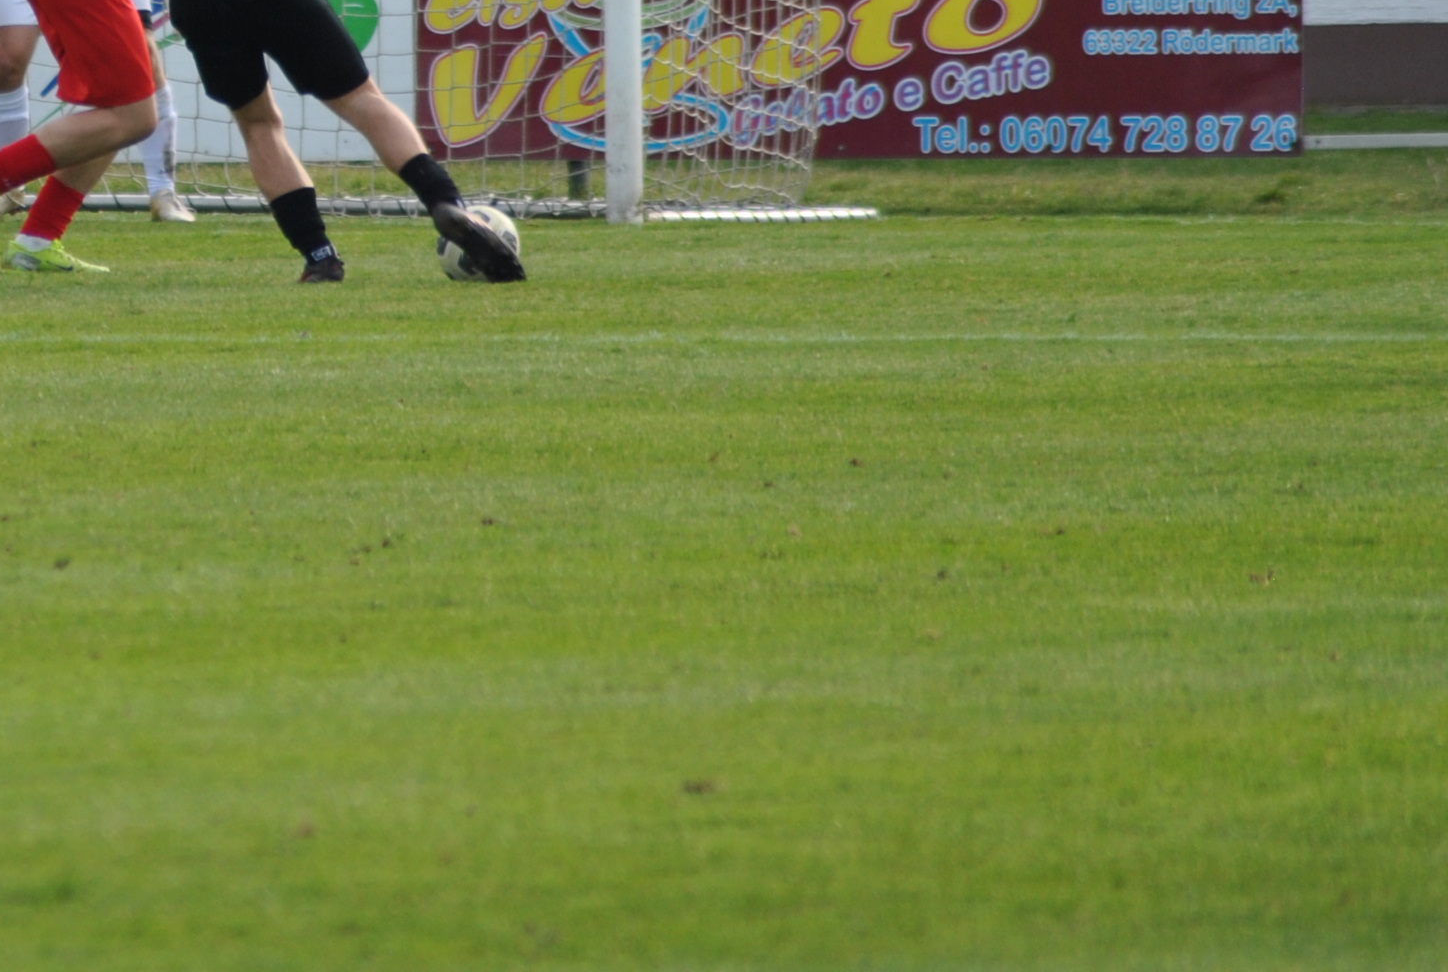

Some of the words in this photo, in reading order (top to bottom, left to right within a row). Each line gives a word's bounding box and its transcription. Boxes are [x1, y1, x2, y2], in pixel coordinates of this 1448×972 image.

[1084, 30, 1157, 54] 63322
[1162, 29, 1299, 54] Rödermark
[730, 80, 884, 148] Gelato
[895, 80, 923, 108] e
[932, 50, 1049, 104] Caffe
[915, 118, 992, 153] Tel.:
[1001, 117, 1110, 153] 06074
[1123, 116, 1185, 152] 728
[1197, 116, 1242, 151] 87
[1253, 115, 1297, 150] 26
